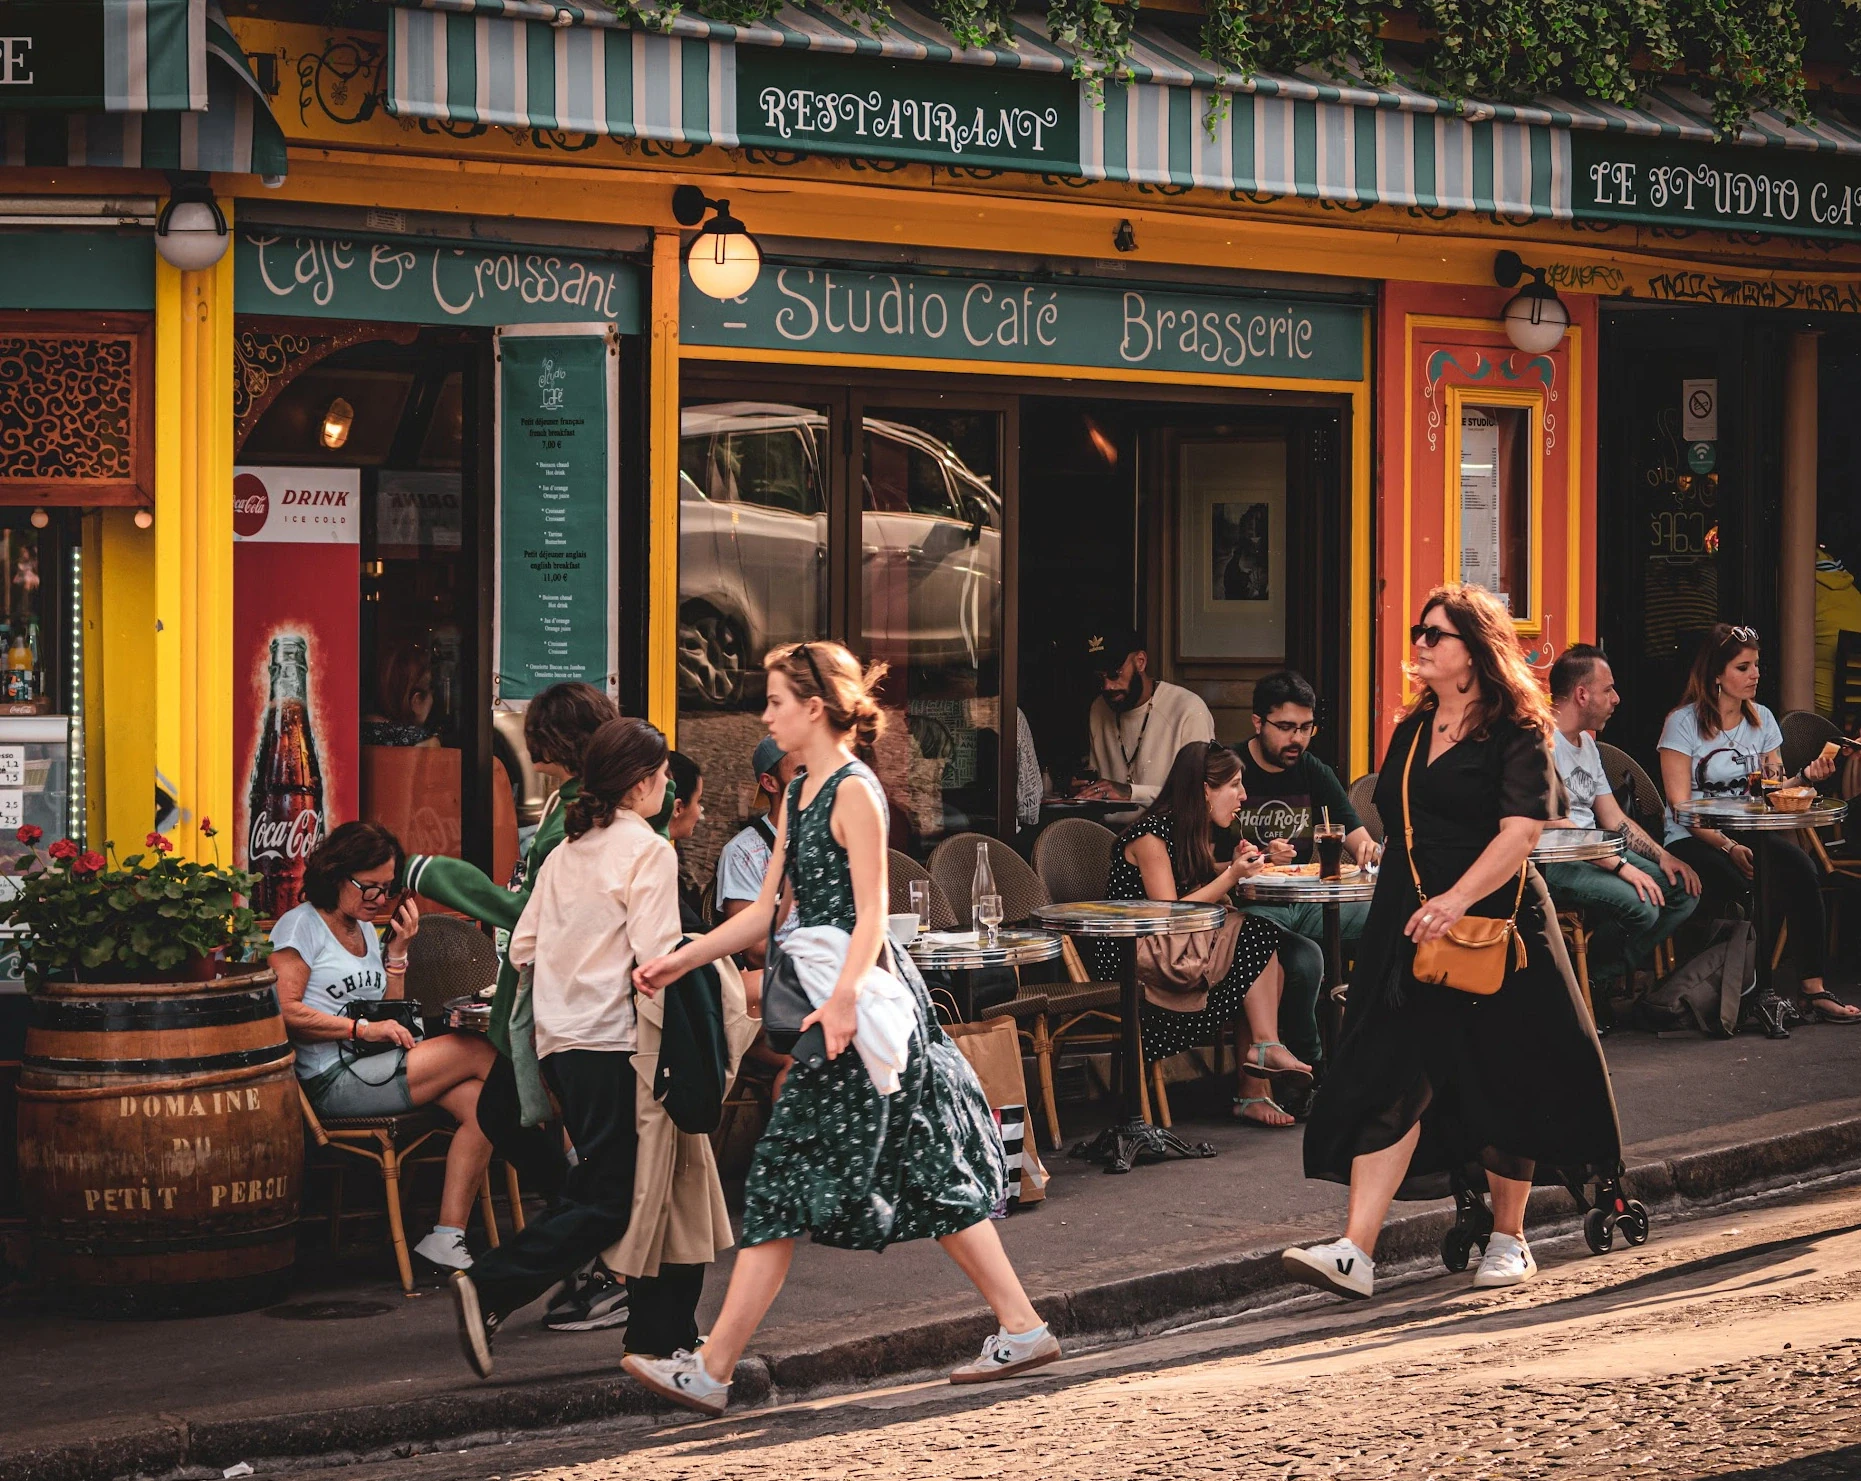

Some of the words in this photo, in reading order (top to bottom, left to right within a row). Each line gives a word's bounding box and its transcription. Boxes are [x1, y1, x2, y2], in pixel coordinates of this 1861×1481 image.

[0, 37, 33, 84] E
[760, 86, 1058, 154] RESTAURANT
[1589, 161, 1637, 206] LE
[1648, 163, 1800, 220] STUDIO
[1810, 182, 1861, 226] CA
[432, 249, 619, 319] Croissant
[775, 269, 949, 341] Studio
[962, 282, 1059, 347] Café
[1119, 291, 1313, 367] Brasserie
[521, 417, 534, 427] Petit
[535, 417, 559, 428] déjeuner
[560, 417, 585, 428] français
[529, 429, 547, 437] french
[548, 429, 575, 437] breakfast
[542, 441, 556, 450] 7,00
[281, 489, 350, 507] DRINK
[284, 515, 306, 523] ICE
[314, 516, 346, 524] COLD
[524, 550, 538, 559] Petit
[539, 550, 564, 560] déjeuner
[565, 550, 587, 560] anglais
[530, 562, 553, 571] english
[553, 562, 581, 570] breakfast
[543, 574, 561, 583] 11,00
[1240, 809, 1273, 826] Hard
[1274, 808, 1309, 829] Rock
[119, 1088, 260, 1117] DOMAINE
